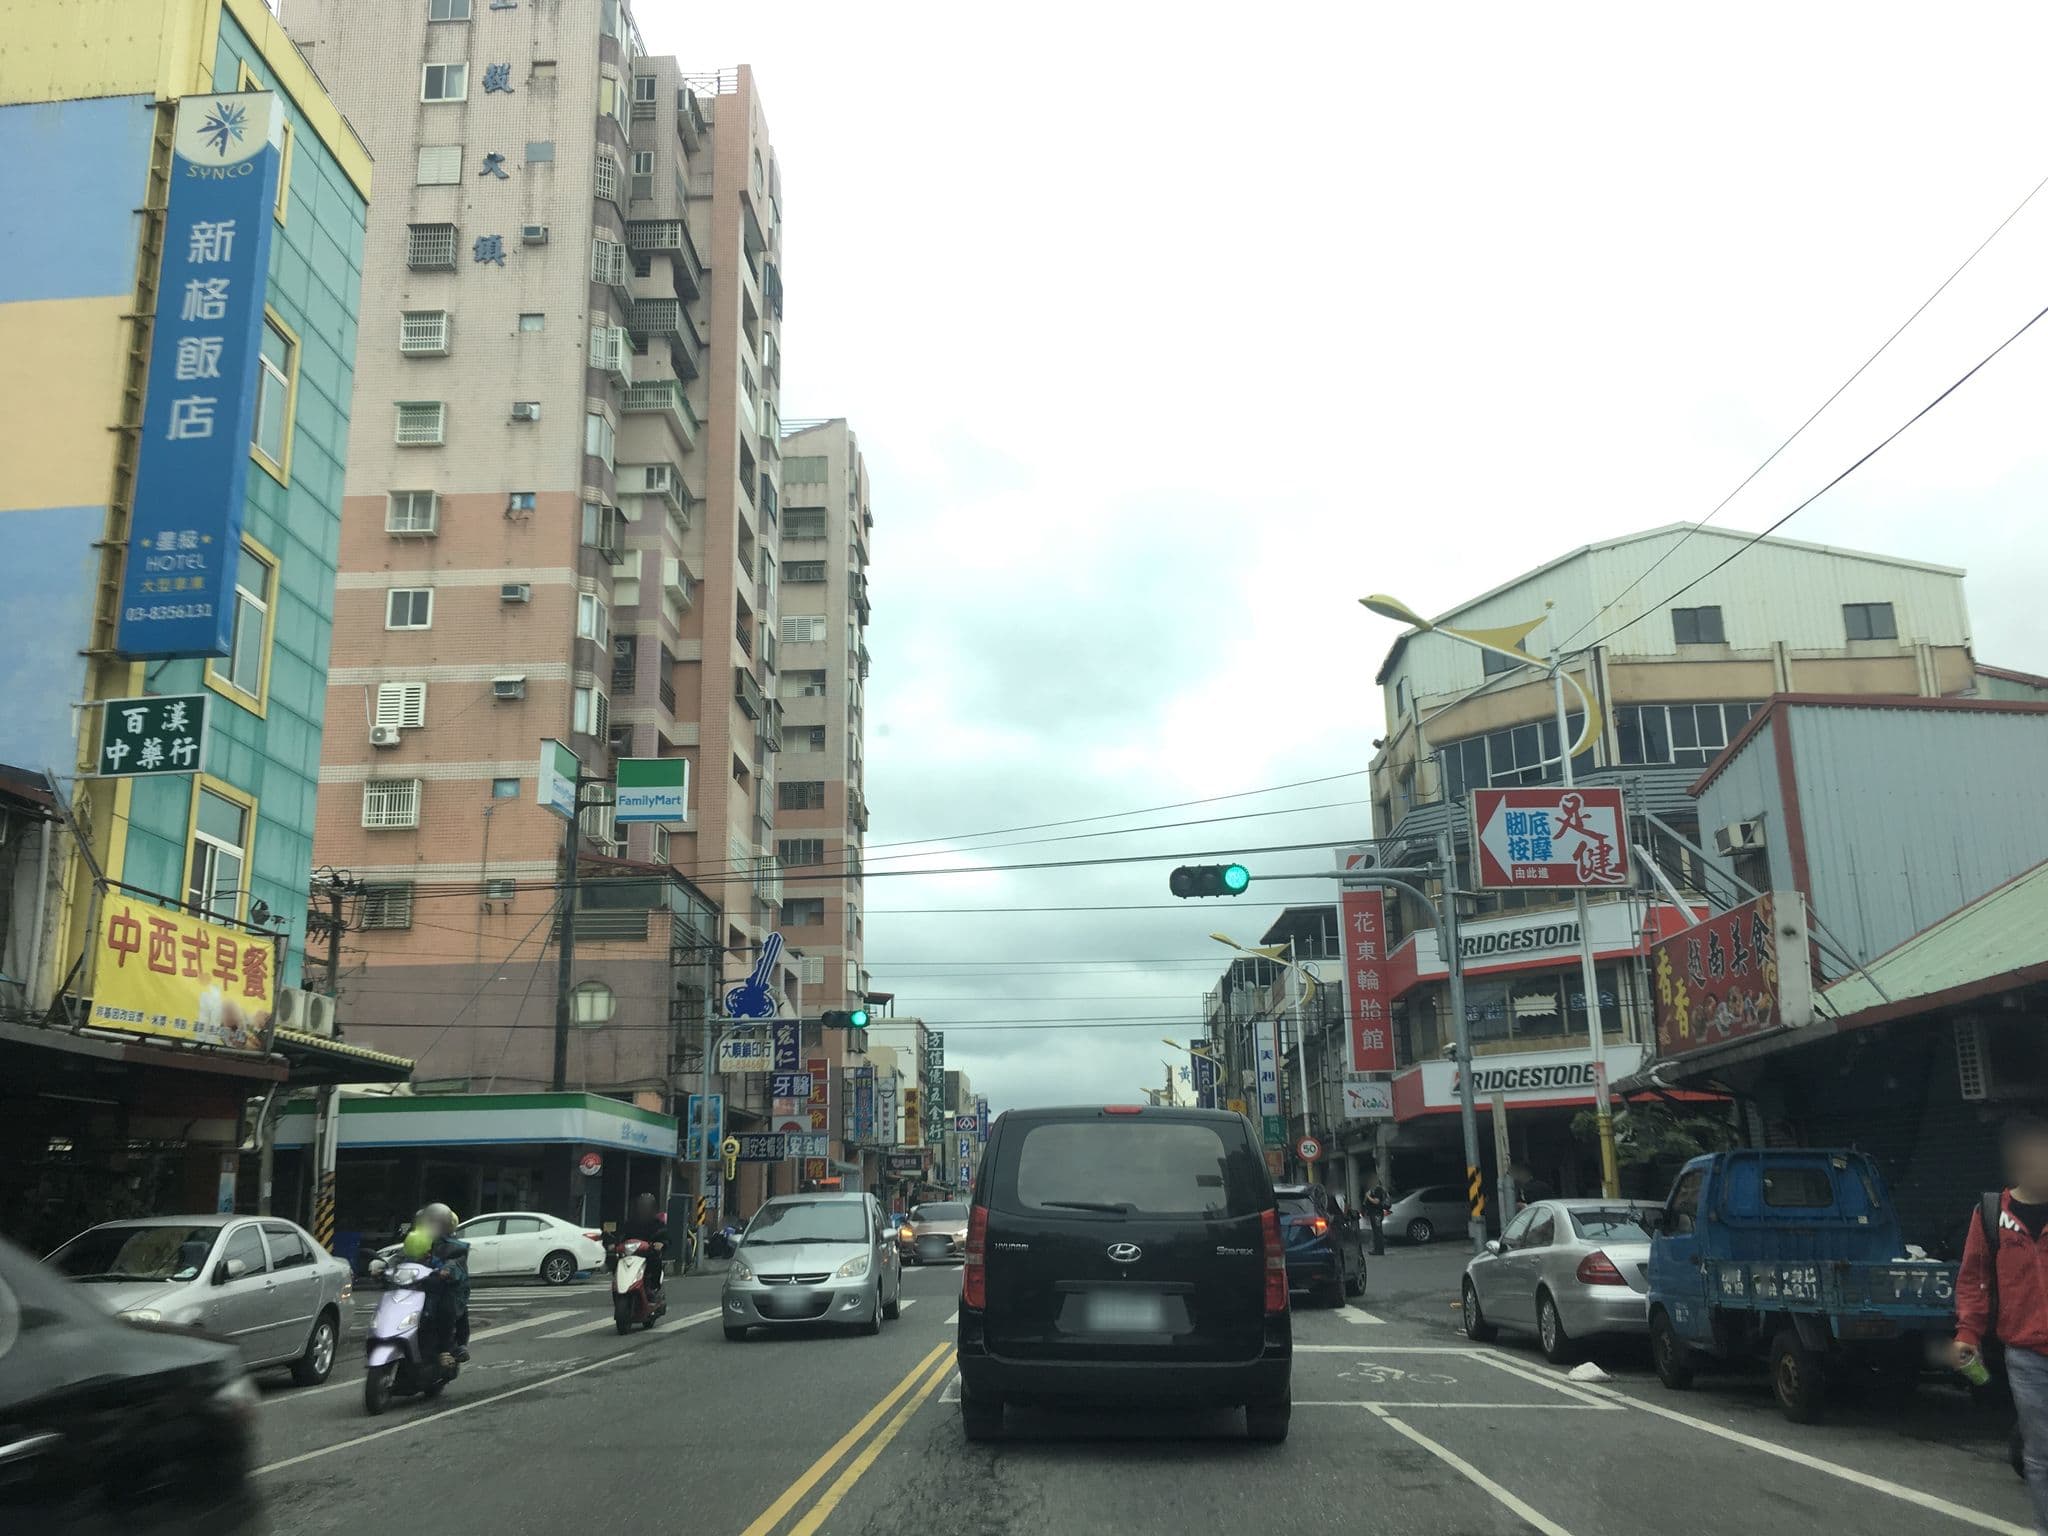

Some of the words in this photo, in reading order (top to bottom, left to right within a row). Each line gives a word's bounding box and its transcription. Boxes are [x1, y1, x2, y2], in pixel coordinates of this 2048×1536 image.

[186, 163, 254, 181] SYNCO
[165, 219, 236, 441] 新格飯店
[145, 553, 207, 572] HOTEL
[106, 737, 198, 770] 中藥行
[618, 794, 681, 808] FamilyMart
[1507, 837, 1554, 862] 按摩
[1515, 867, 1550, 879] 由此進
[108, 906, 268, 1000] 中西式早餐
[1457, 922, 1582, 957] RIDGESTON
[1687, 910, 1770, 990] 越南美食
[1353, 911, 1384, 1050] 花東輪胎館
[773, 1076, 810, 1096] 牙醫
[1200, 1062, 1211, 1094] TECO
[1303, 1144, 1317, 1154] 50
